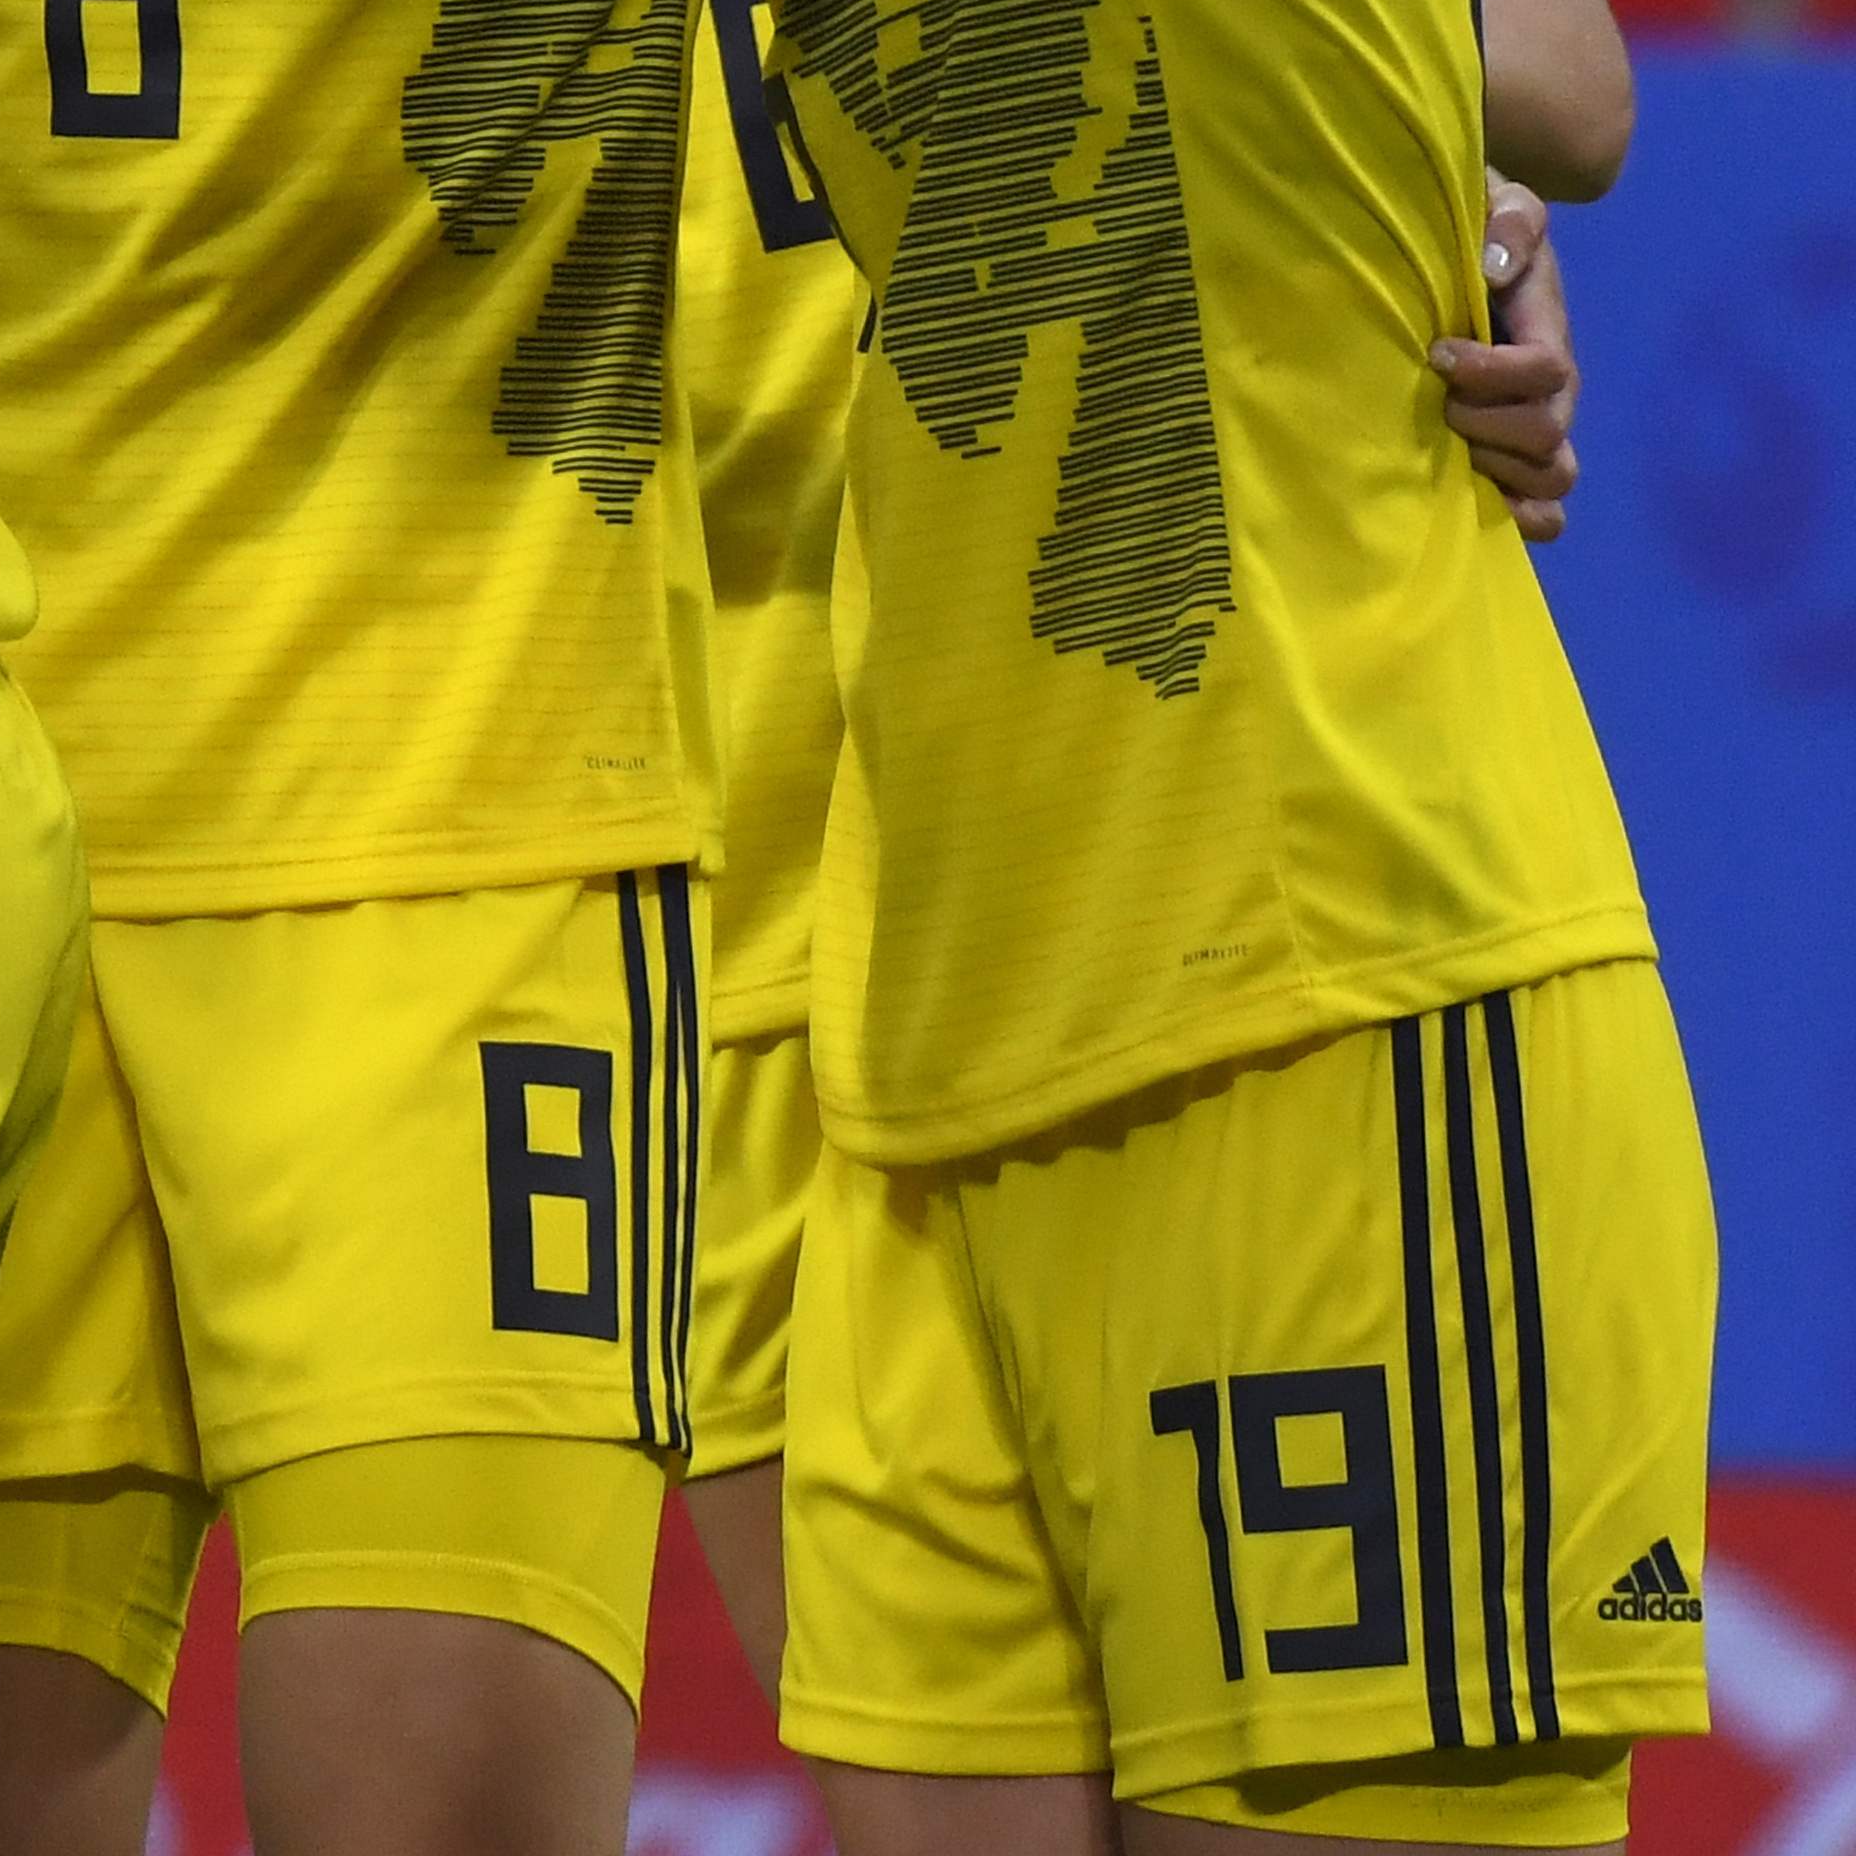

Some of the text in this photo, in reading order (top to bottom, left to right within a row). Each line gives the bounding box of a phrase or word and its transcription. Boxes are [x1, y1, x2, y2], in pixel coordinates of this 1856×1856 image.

[479, 1041, 620, 1343] 8
[1149, 1363, 1409, 1682] 19
[1597, 1594, 1703, 1623] adidas
